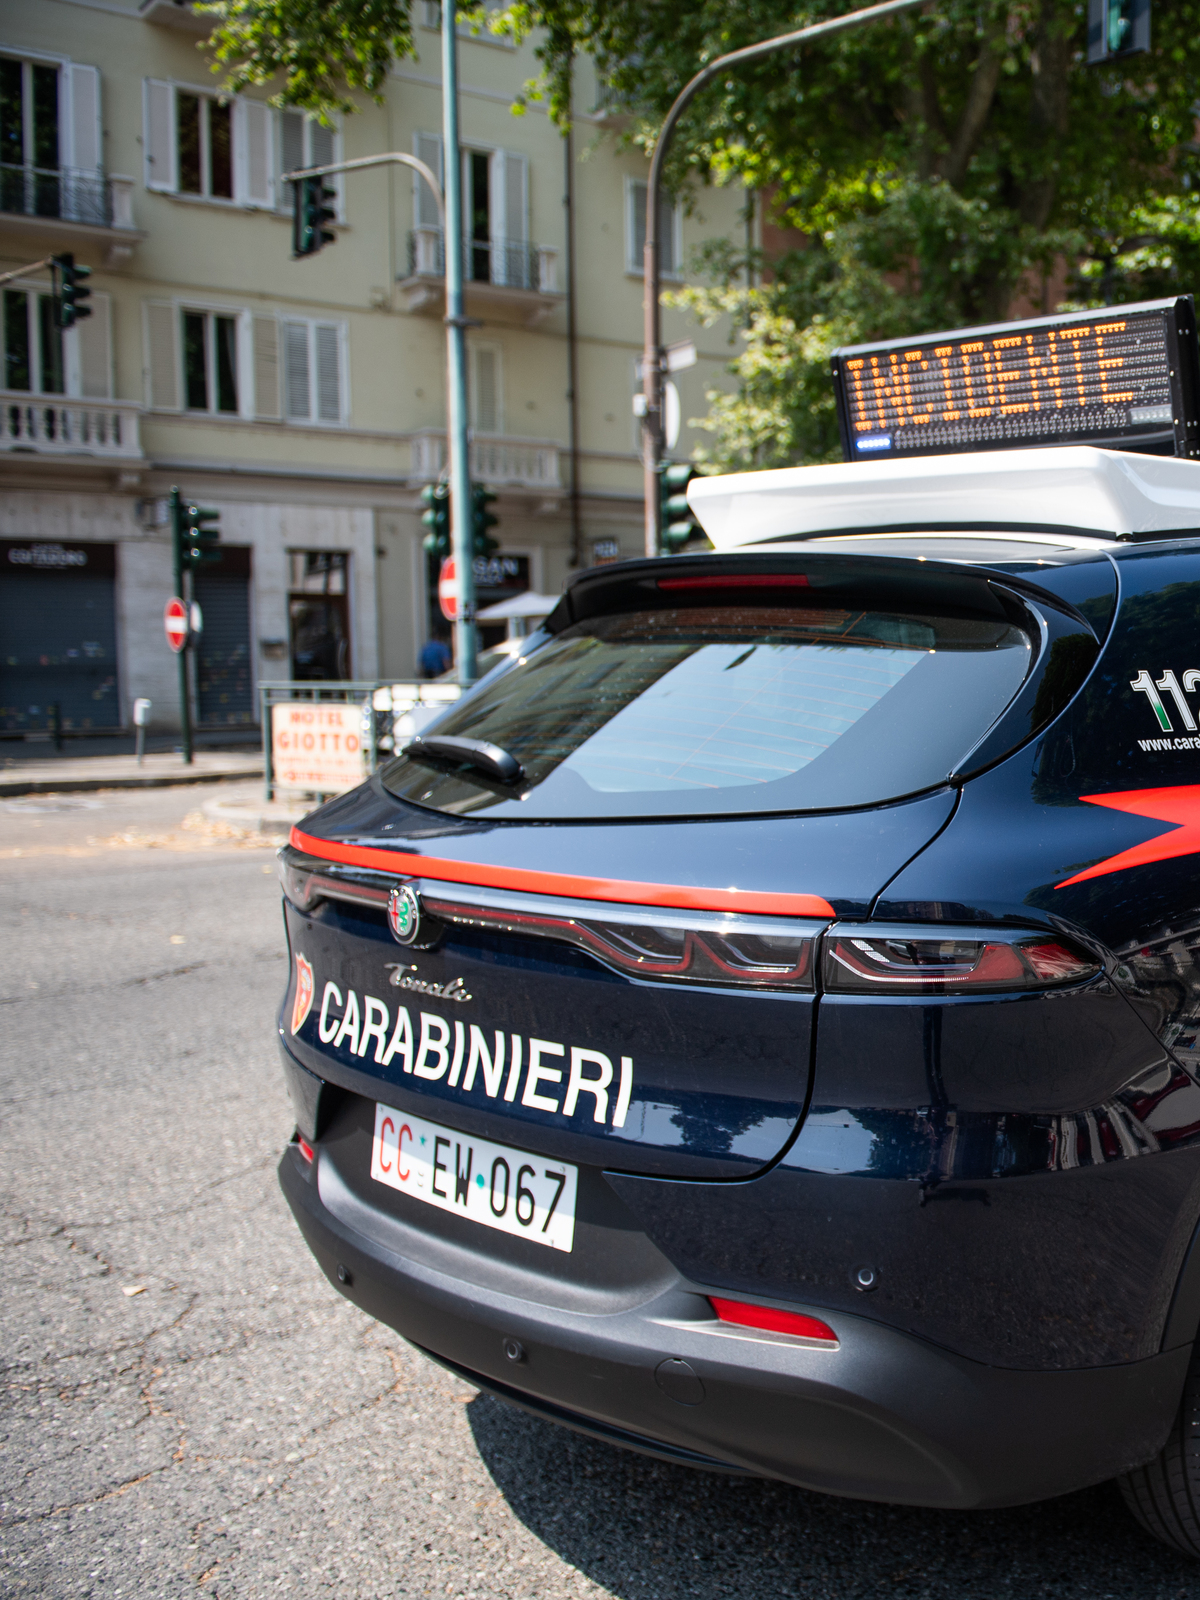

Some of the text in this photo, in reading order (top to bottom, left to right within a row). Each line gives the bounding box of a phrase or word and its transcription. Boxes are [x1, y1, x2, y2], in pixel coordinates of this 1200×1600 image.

[846, 322, 1133, 431] INCIDENTE
[277, 731, 360, 753] GIOTTO
[289, 711, 344, 727] HOTEL
[383, 962, 473, 1002] Tonale
[318, 981, 633, 1128] CARABINIERI
[379, 1117, 412, 1181] CC
